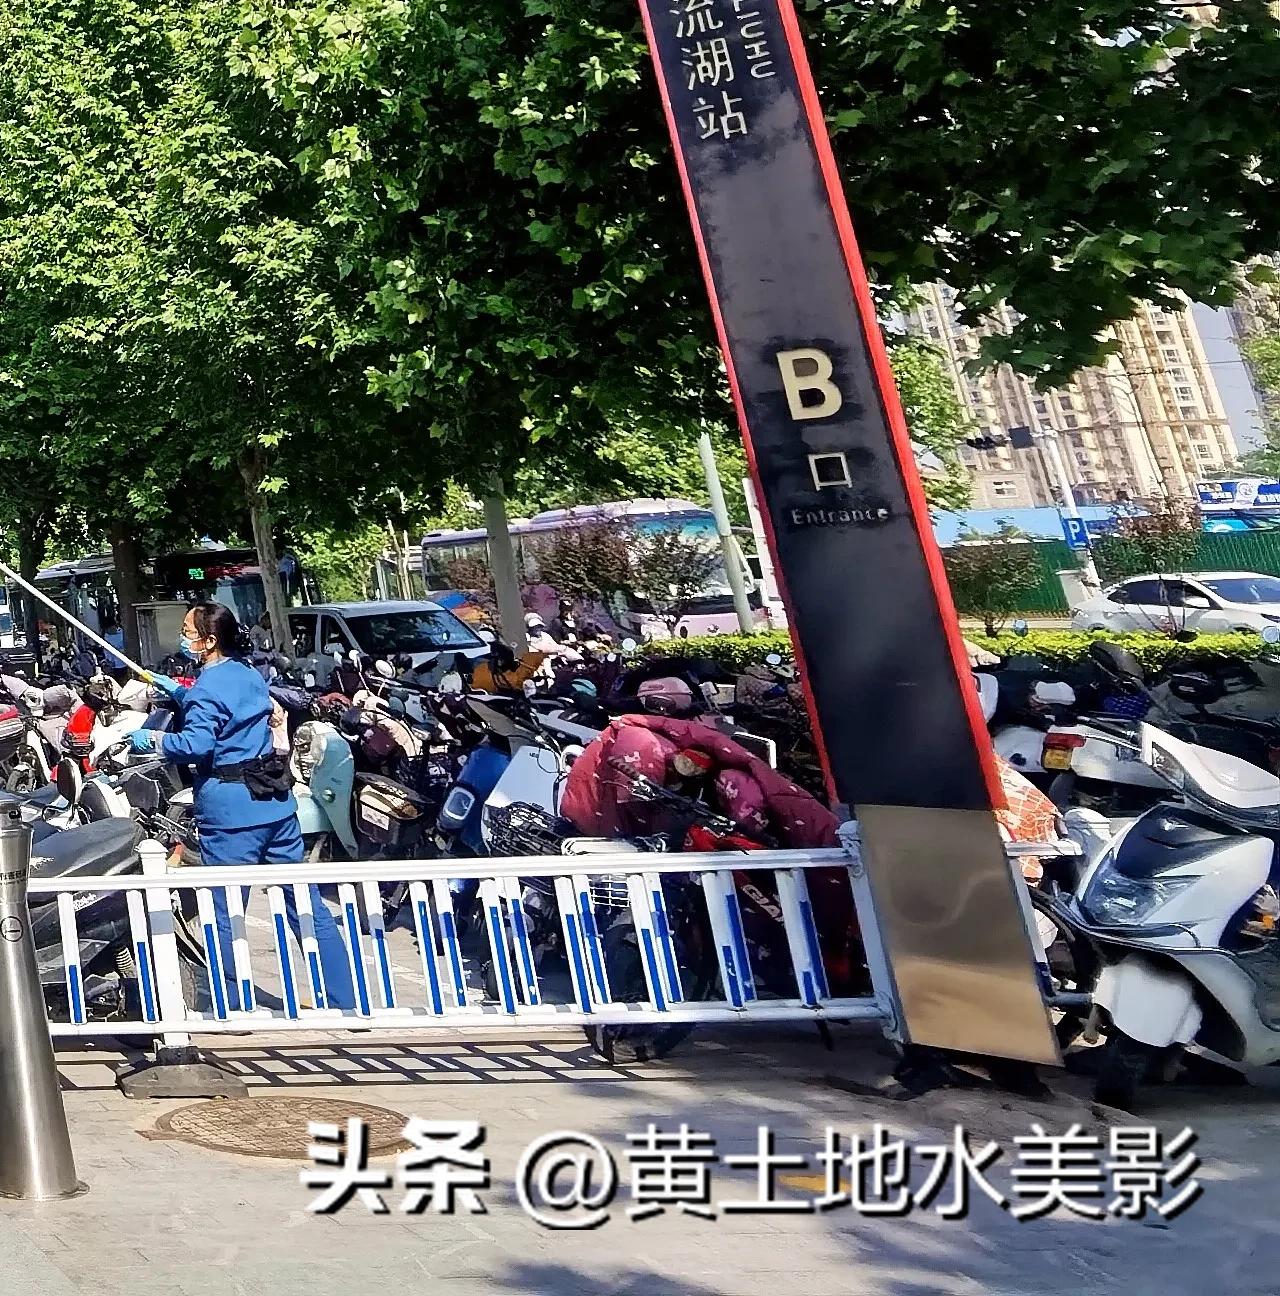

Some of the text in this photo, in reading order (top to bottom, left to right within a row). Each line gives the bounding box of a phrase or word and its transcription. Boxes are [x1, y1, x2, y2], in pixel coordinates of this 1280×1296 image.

[775, 347, 843, 421] B
[807, 452, 853, 492] 口
[792, 507, 890, 526] Entrance
[1068, 520, 1081, 541] P
